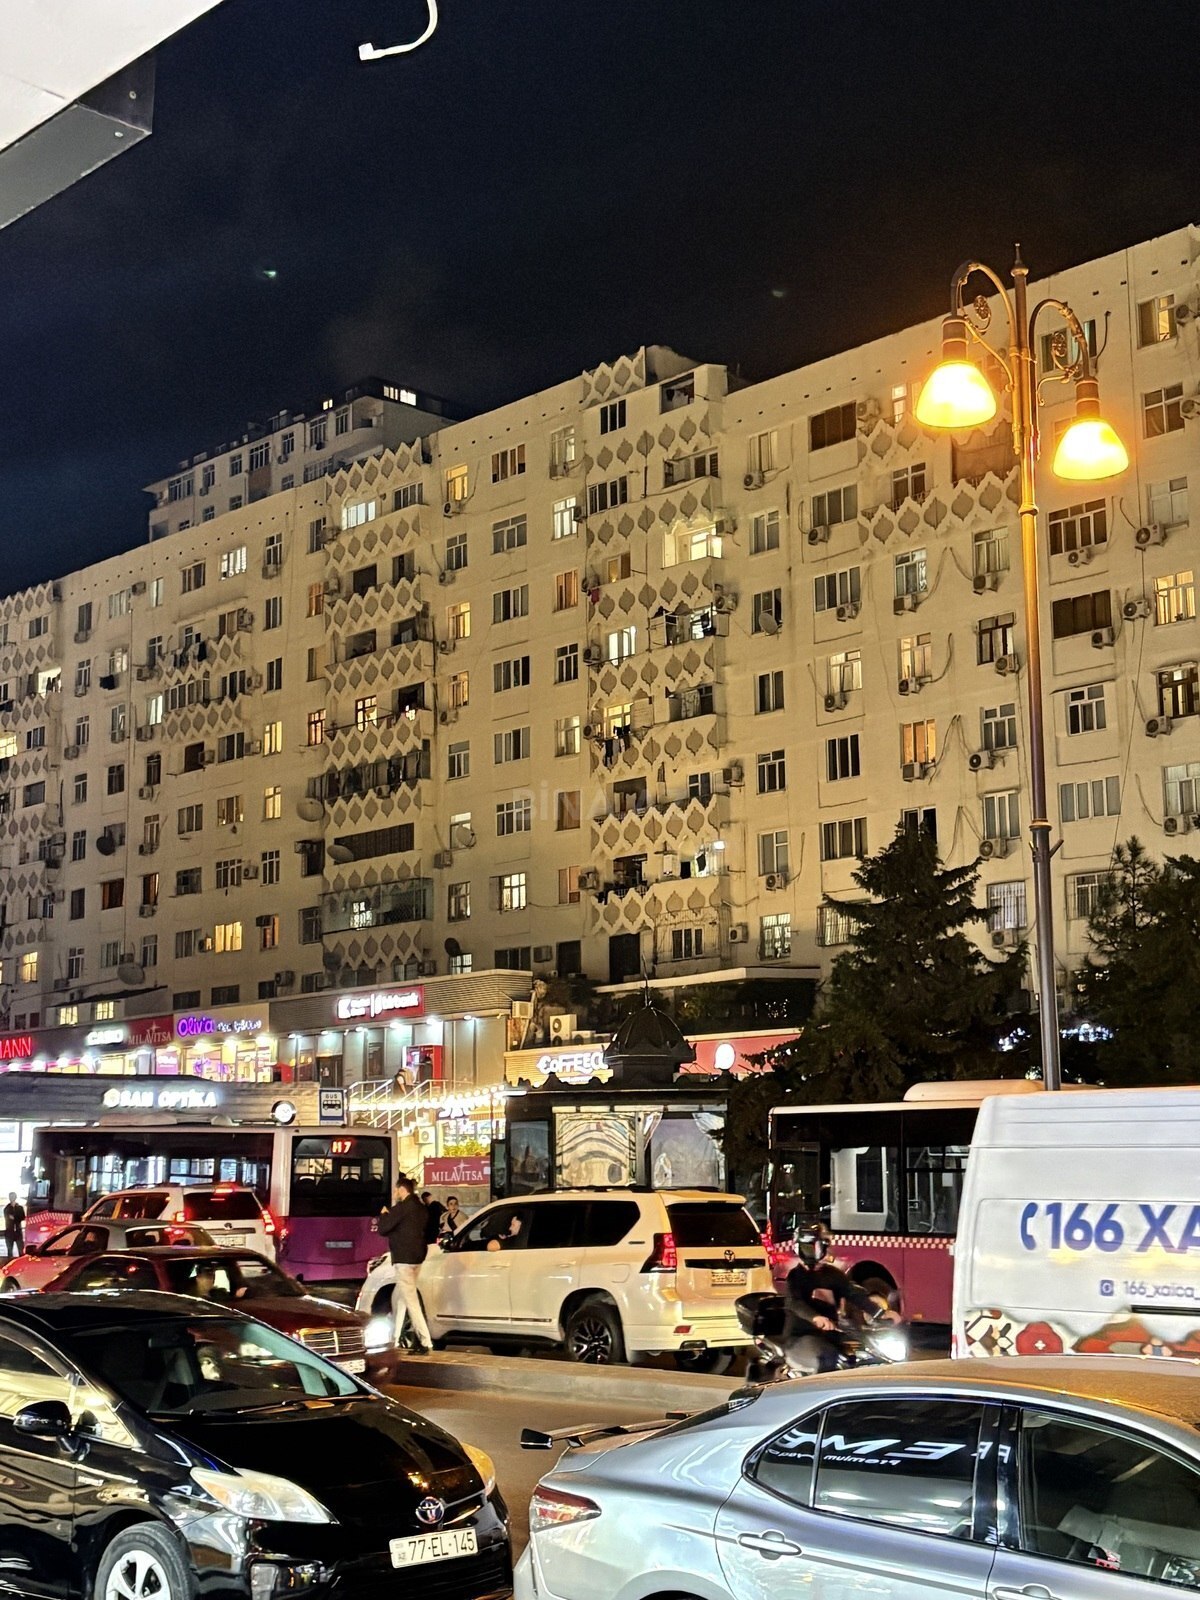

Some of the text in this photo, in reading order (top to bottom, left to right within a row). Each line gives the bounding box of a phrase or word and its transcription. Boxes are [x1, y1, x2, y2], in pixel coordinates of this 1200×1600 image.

[178, 1016, 215, 1037] Olivia
[128, 1028, 172, 1046] MILAVITSA
[431, 1167, 484, 1183] MILAVITSA
[1045, 1203, 1125, 1252] 166
